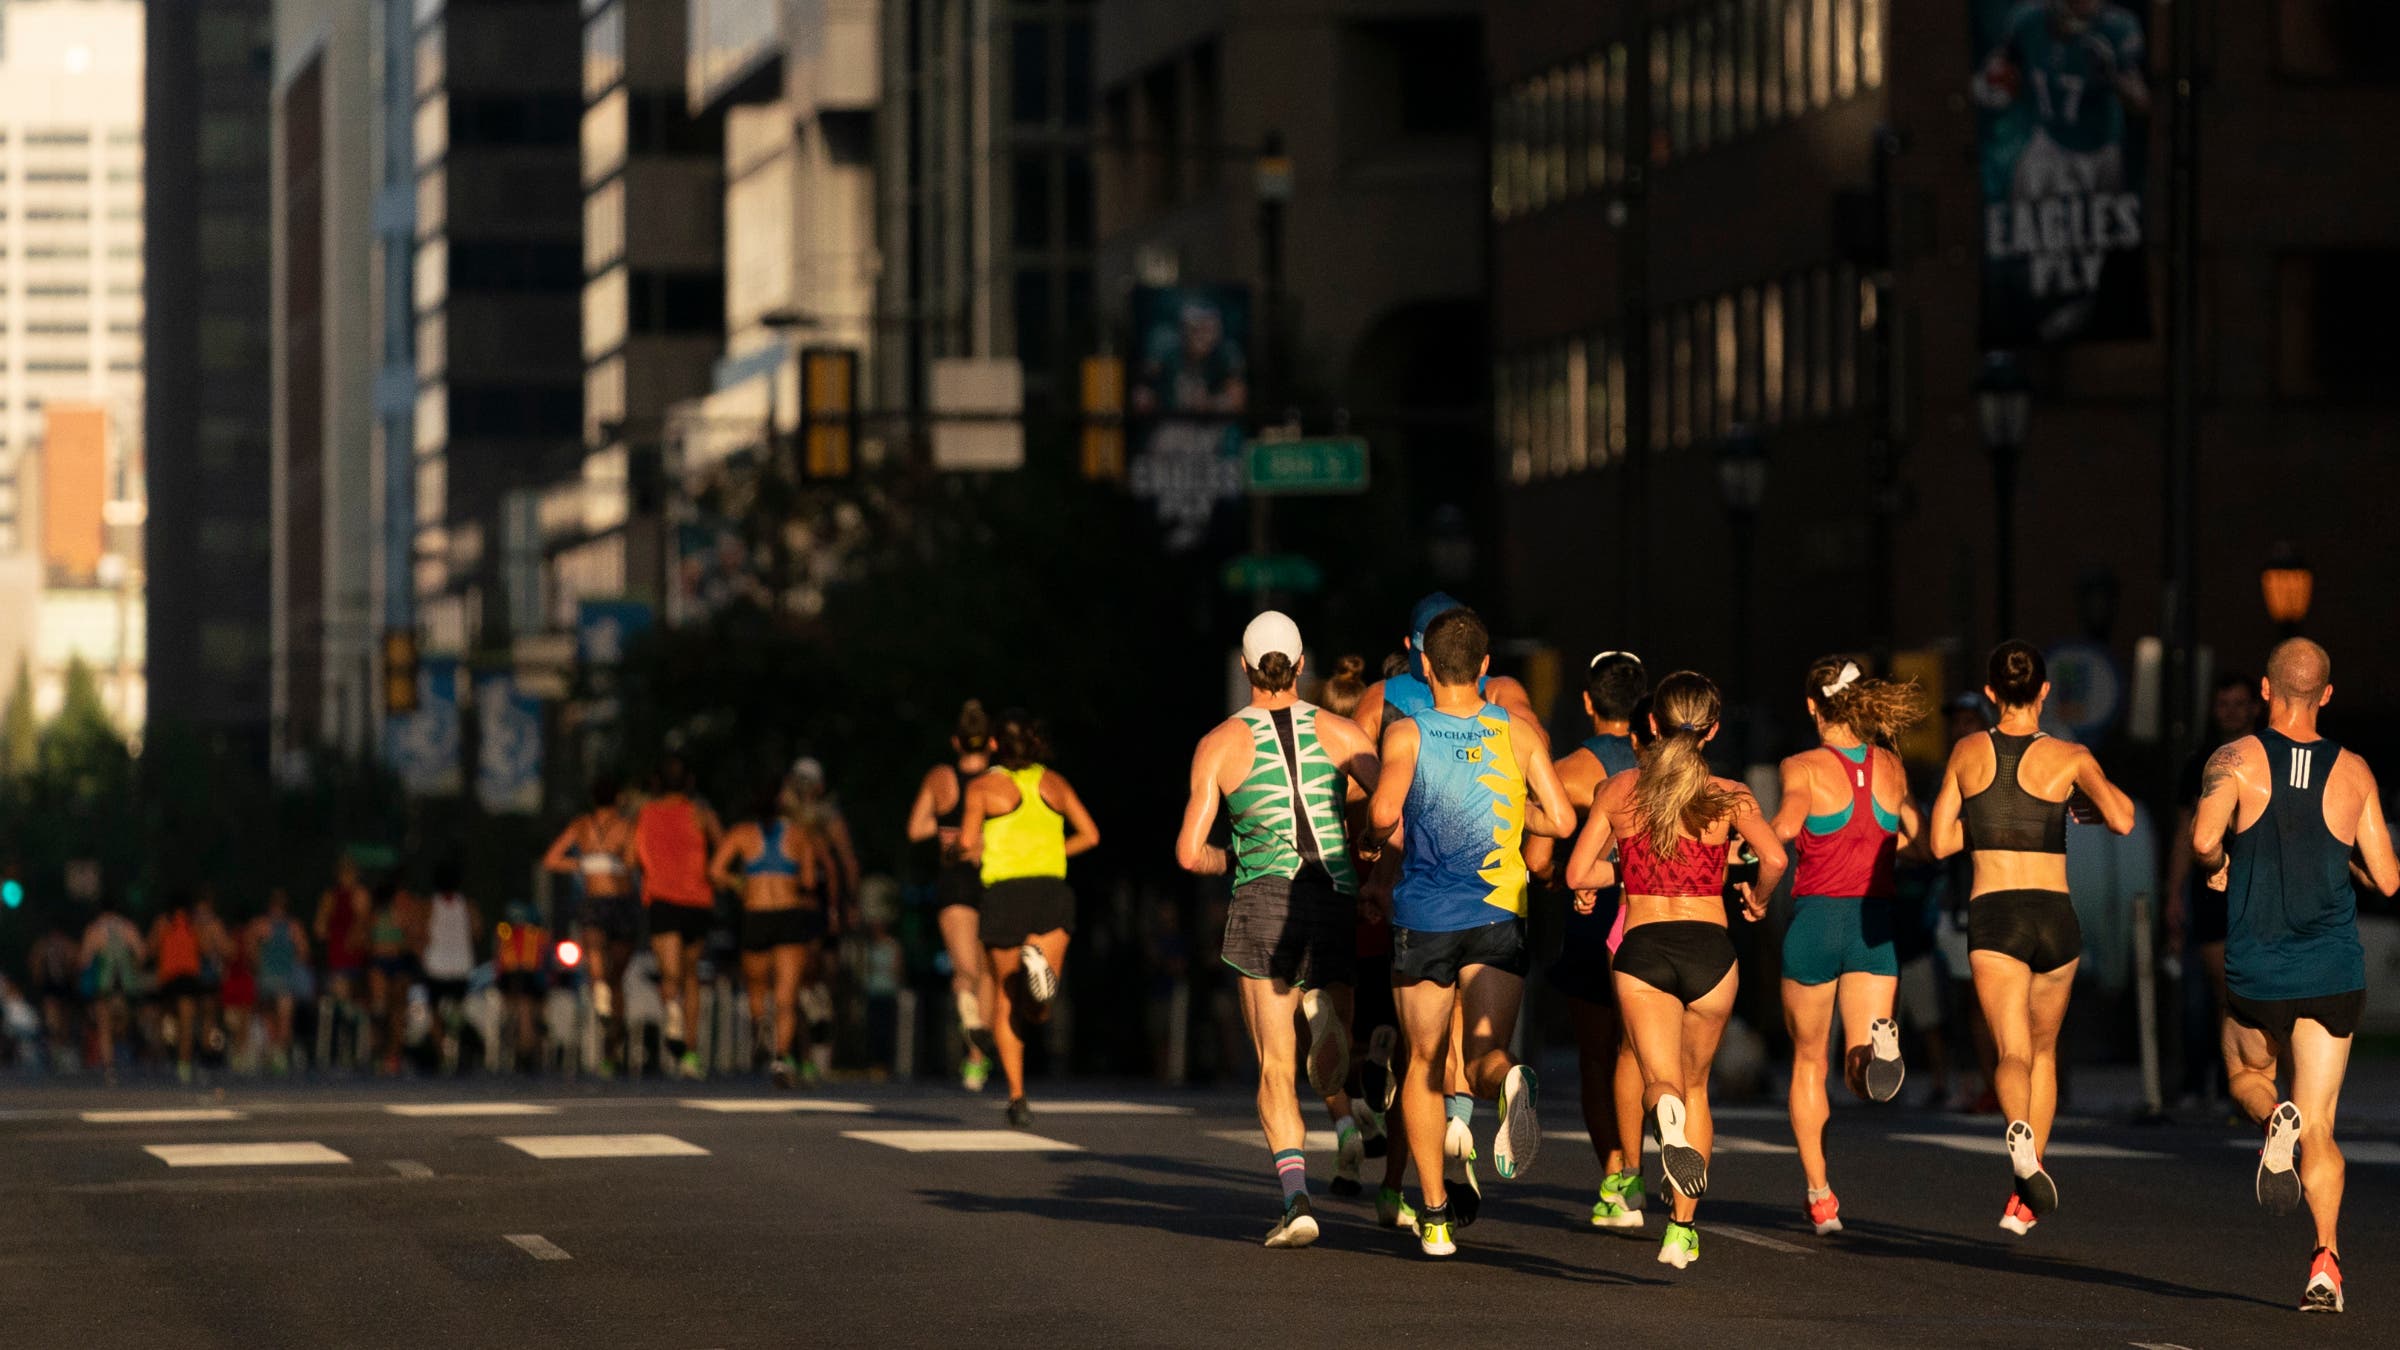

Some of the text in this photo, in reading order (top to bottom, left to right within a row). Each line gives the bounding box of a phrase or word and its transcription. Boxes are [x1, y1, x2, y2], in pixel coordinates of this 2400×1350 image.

[2031, 67, 2085, 123] 17
[1986, 192, 2142, 259] EAGLES
[2031, 250, 2106, 299] FLY
